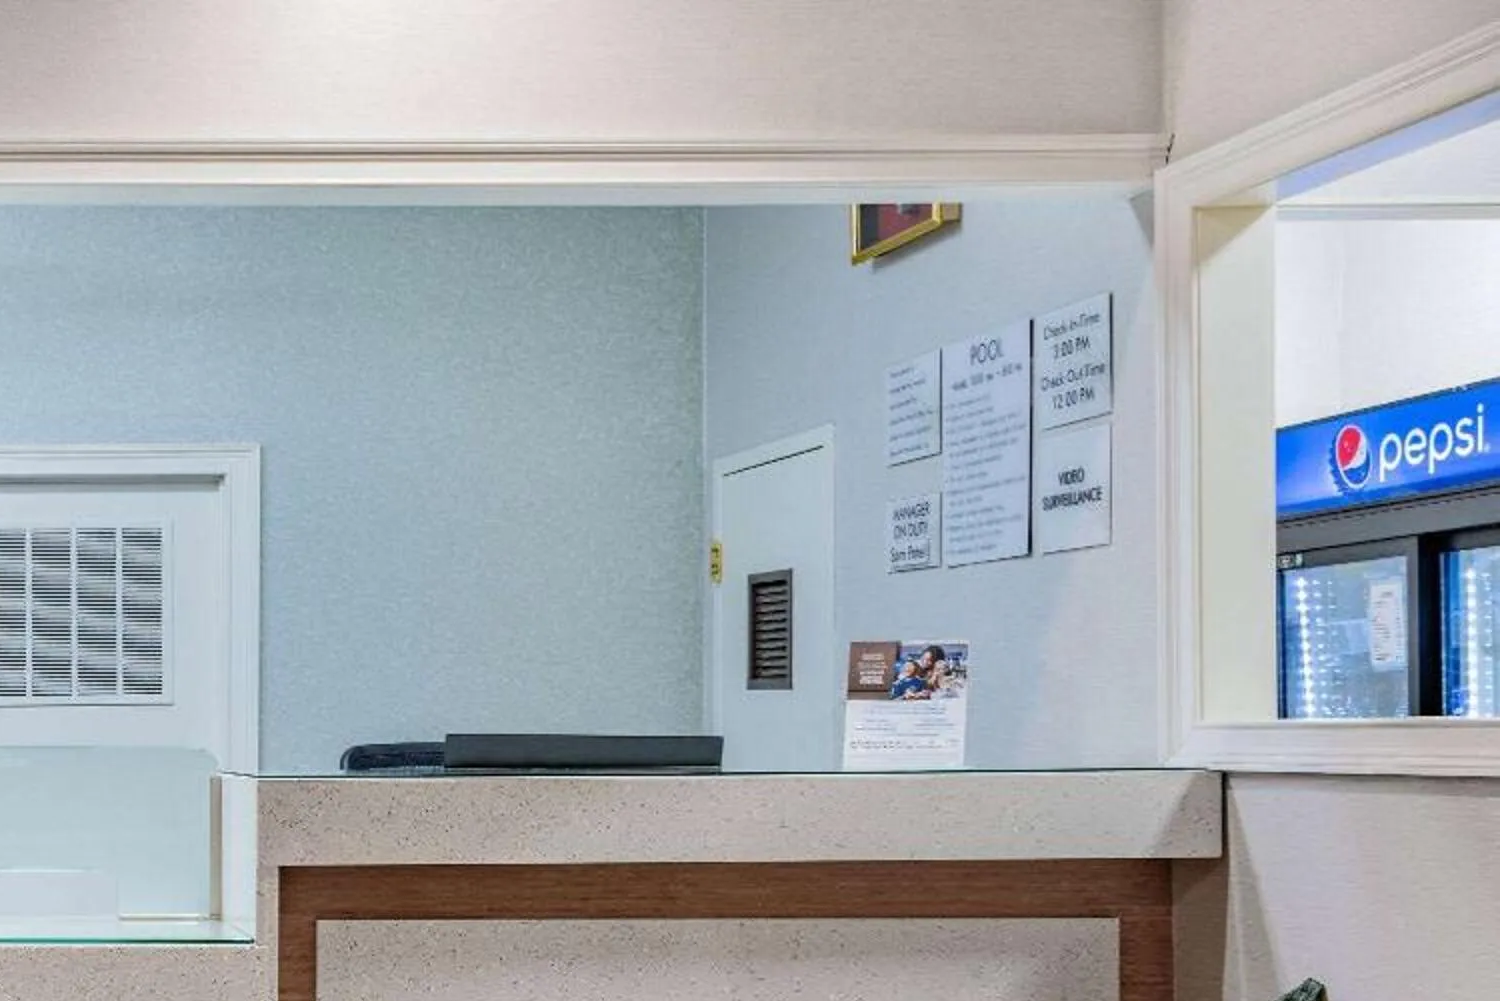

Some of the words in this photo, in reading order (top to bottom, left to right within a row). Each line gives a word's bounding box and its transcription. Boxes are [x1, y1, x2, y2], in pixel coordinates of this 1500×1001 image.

[969, 338, 1004, 366] POOL
[1075, 334, 1091, 352] PM
[1080, 386, 1096, 402] PM
[1380, 402, 1485, 483] pepsi
[1058, 467, 1085, 486] VIDEO
[893, 500, 931, 521] MANAGER
[894, 525, 907, 540] ON
[908, 521, 929, 538] DUTY
